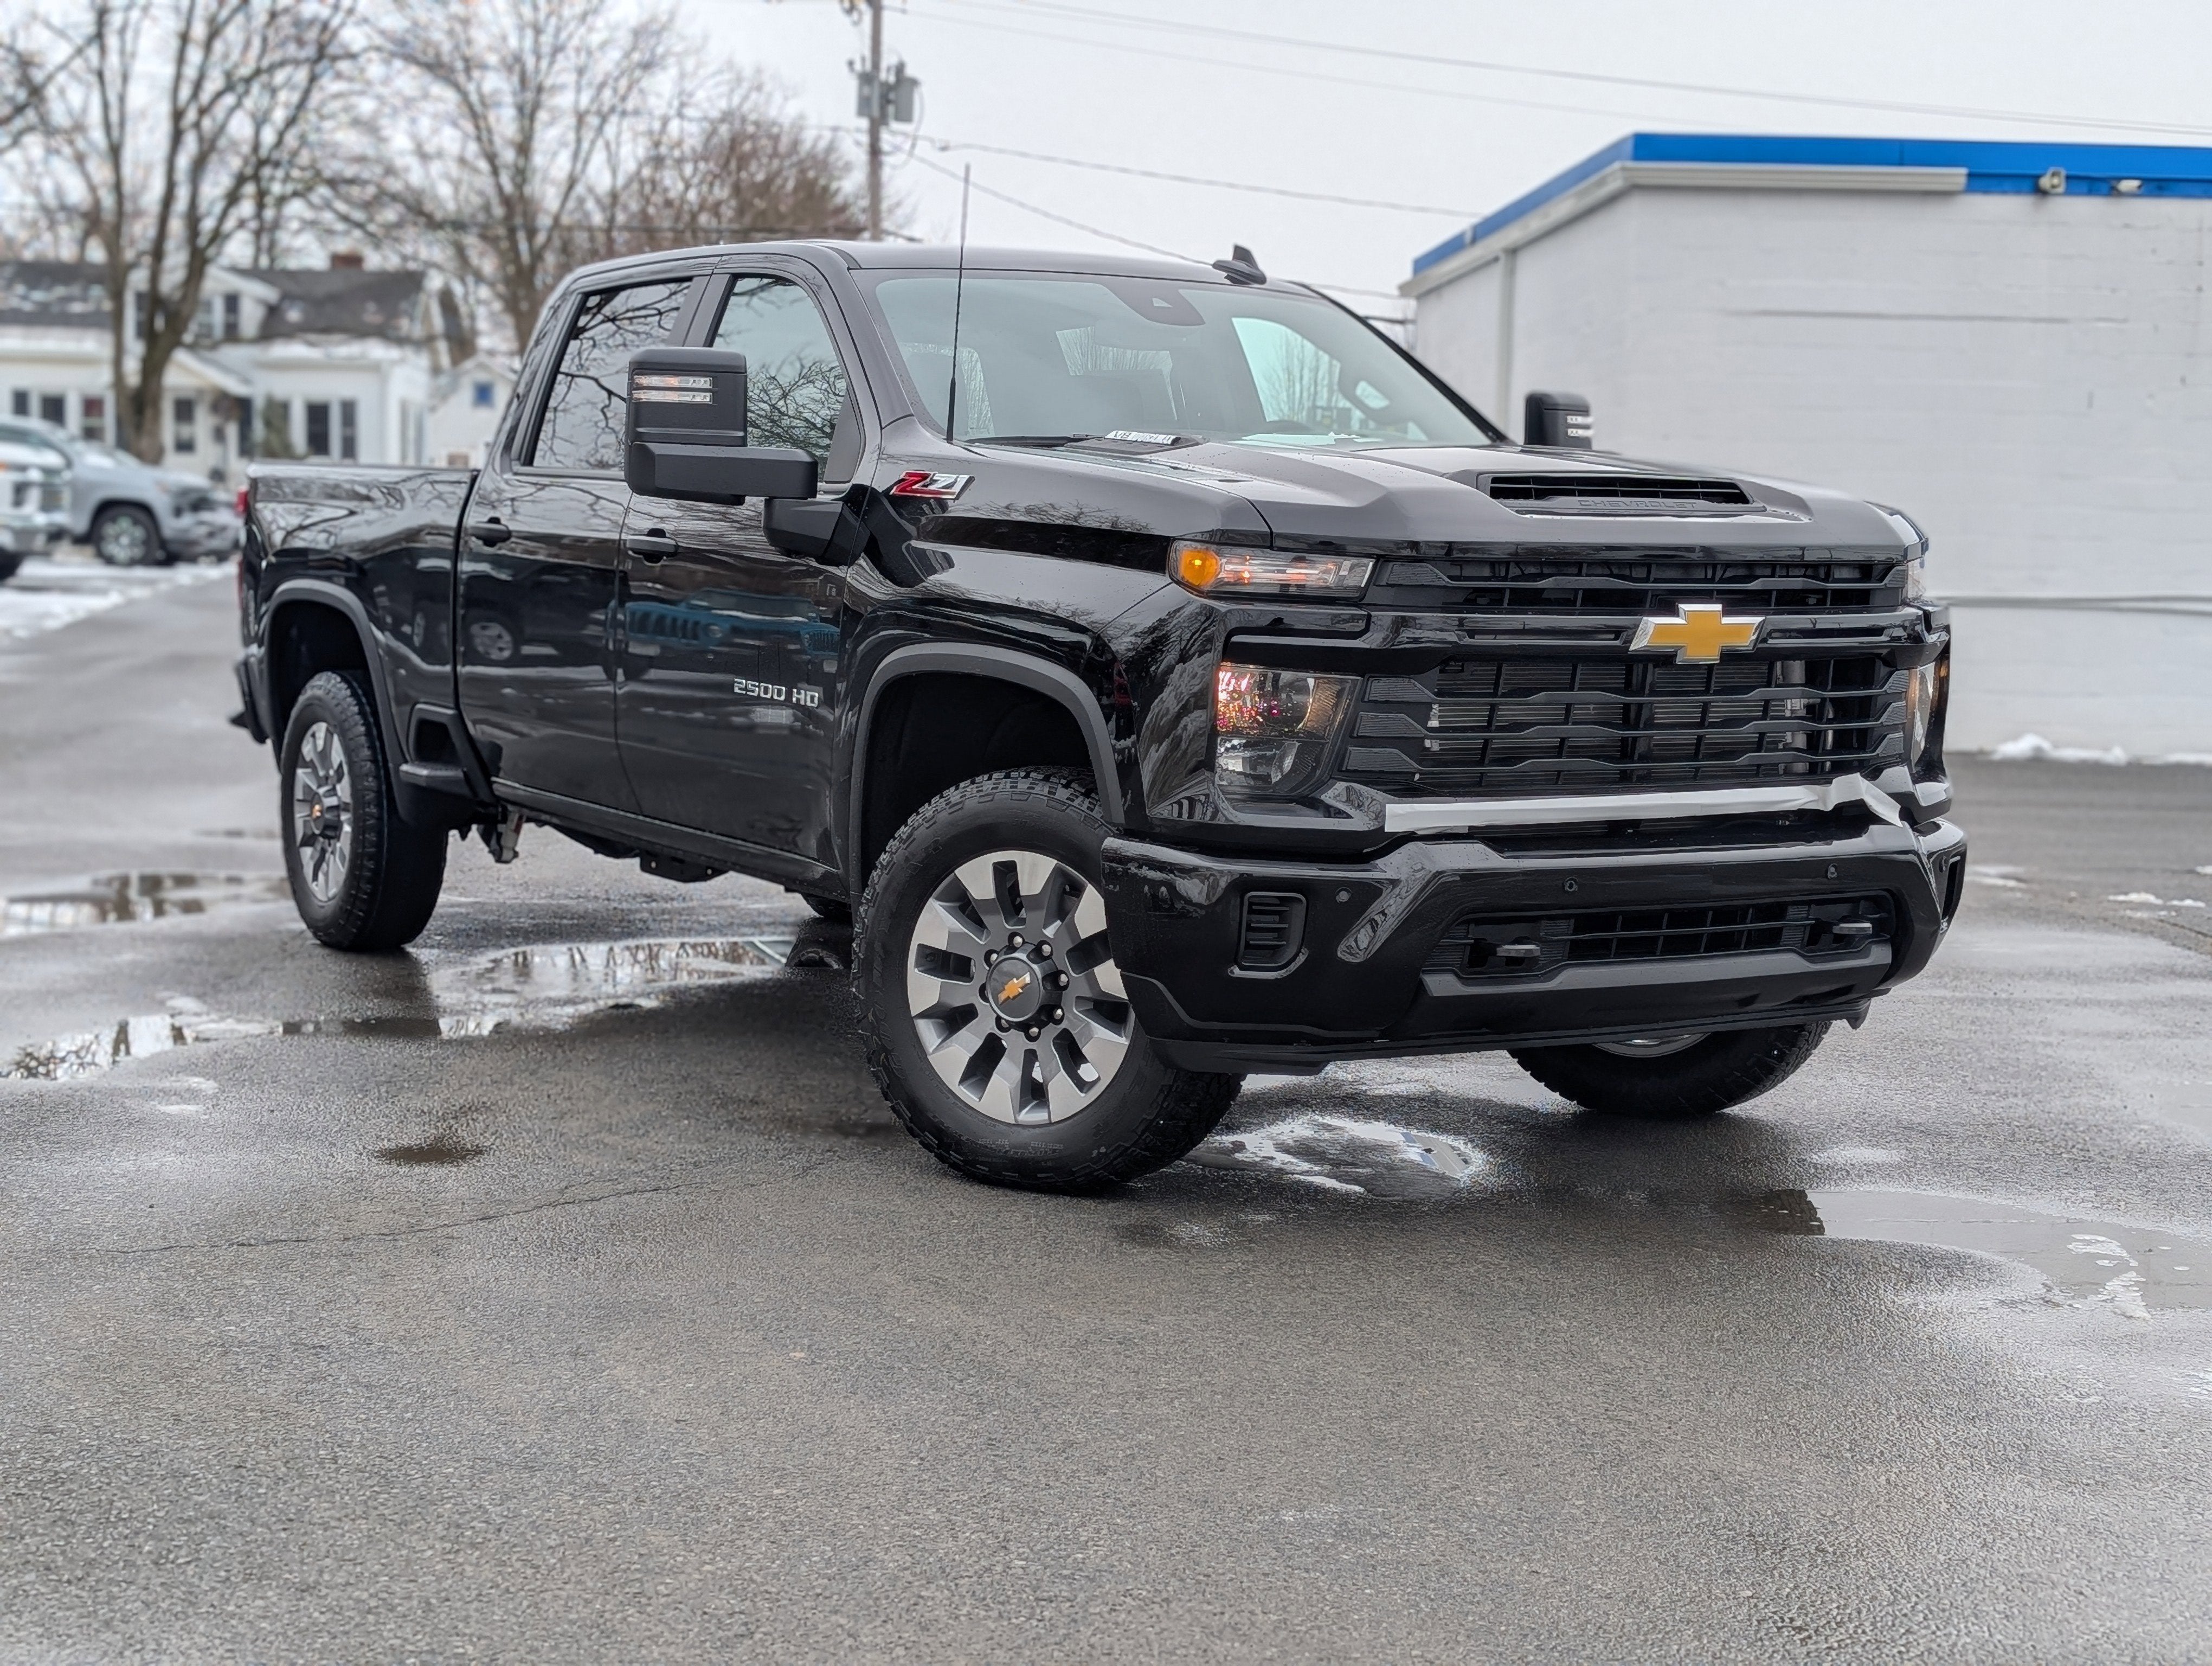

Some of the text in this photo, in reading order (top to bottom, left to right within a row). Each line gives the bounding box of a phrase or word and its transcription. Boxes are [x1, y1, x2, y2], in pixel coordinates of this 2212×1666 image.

[890, 470, 973, 499] Z71
[1578, 500, 1697, 509] CHEVROLET
[734, 678, 819, 707] 2500 HD
